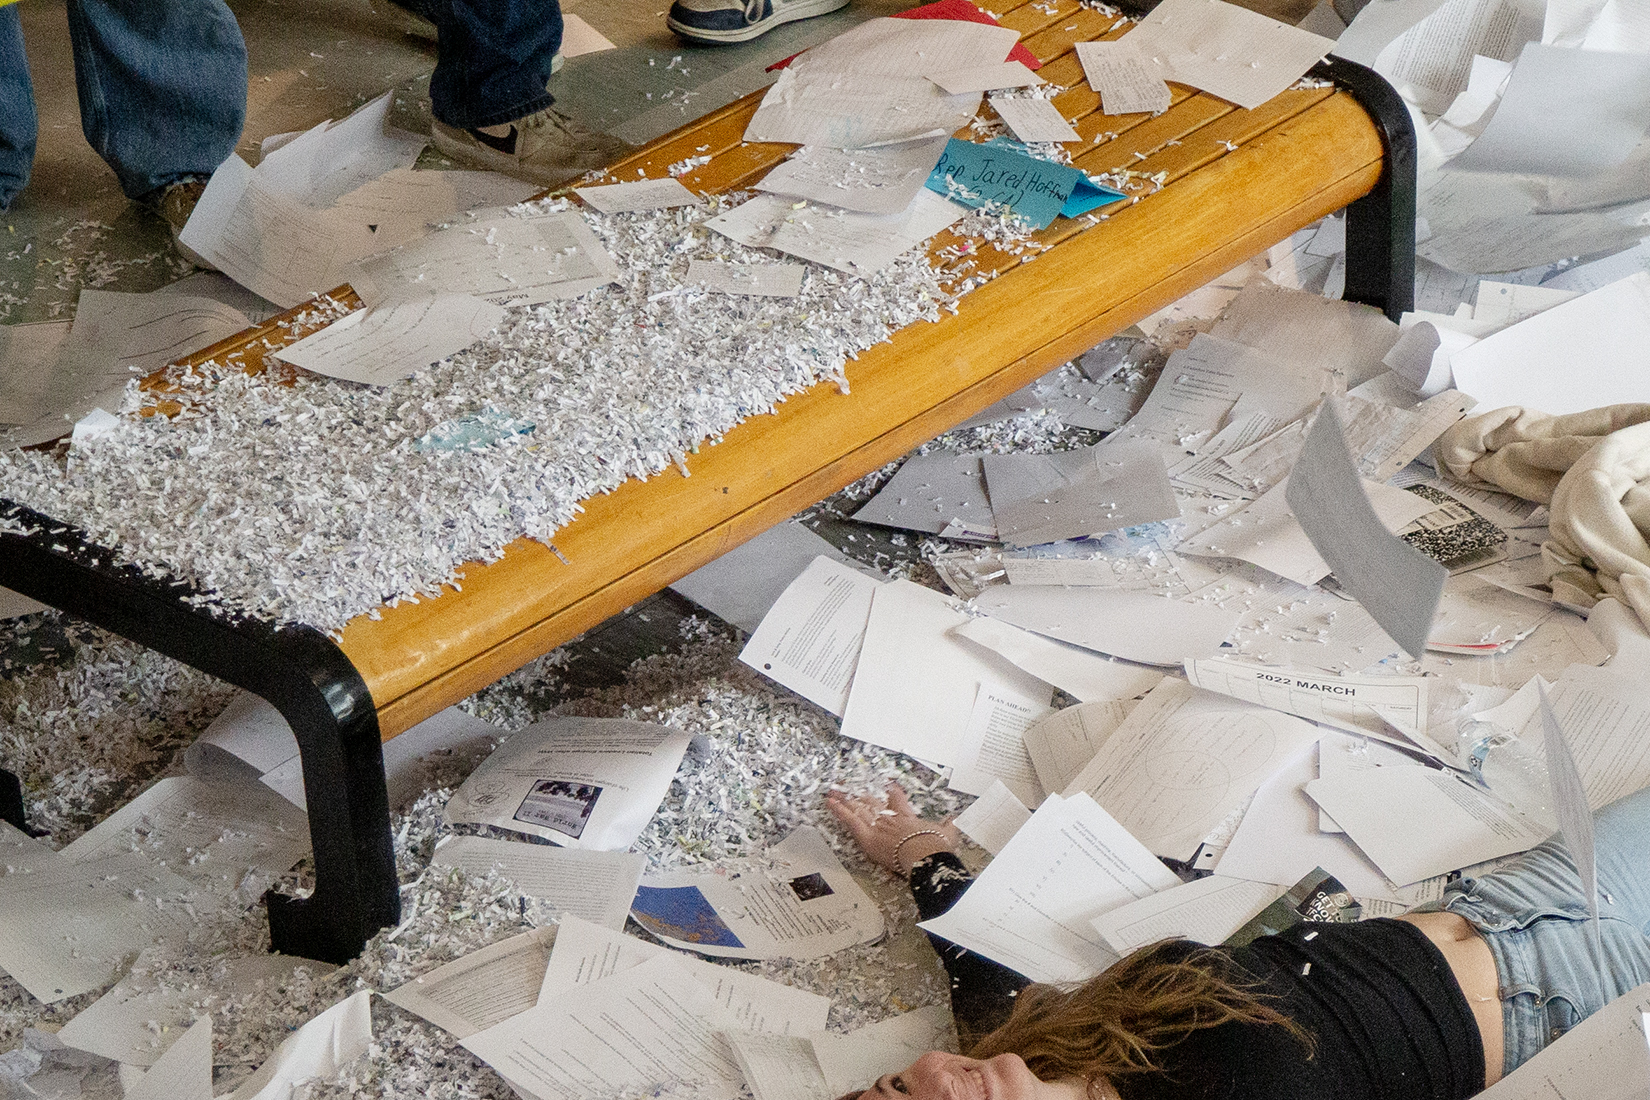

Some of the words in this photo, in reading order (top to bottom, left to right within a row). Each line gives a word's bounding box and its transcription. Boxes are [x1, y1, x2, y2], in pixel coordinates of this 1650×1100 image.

[972, 158, 1027, 189] Jared
[1256, 672, 1291, 685] 2022
[1296, 680, 1355, 696] MARCH
[987, 694, 1004, 704] PLAN
[1316, 891, 1334, 907] GET
